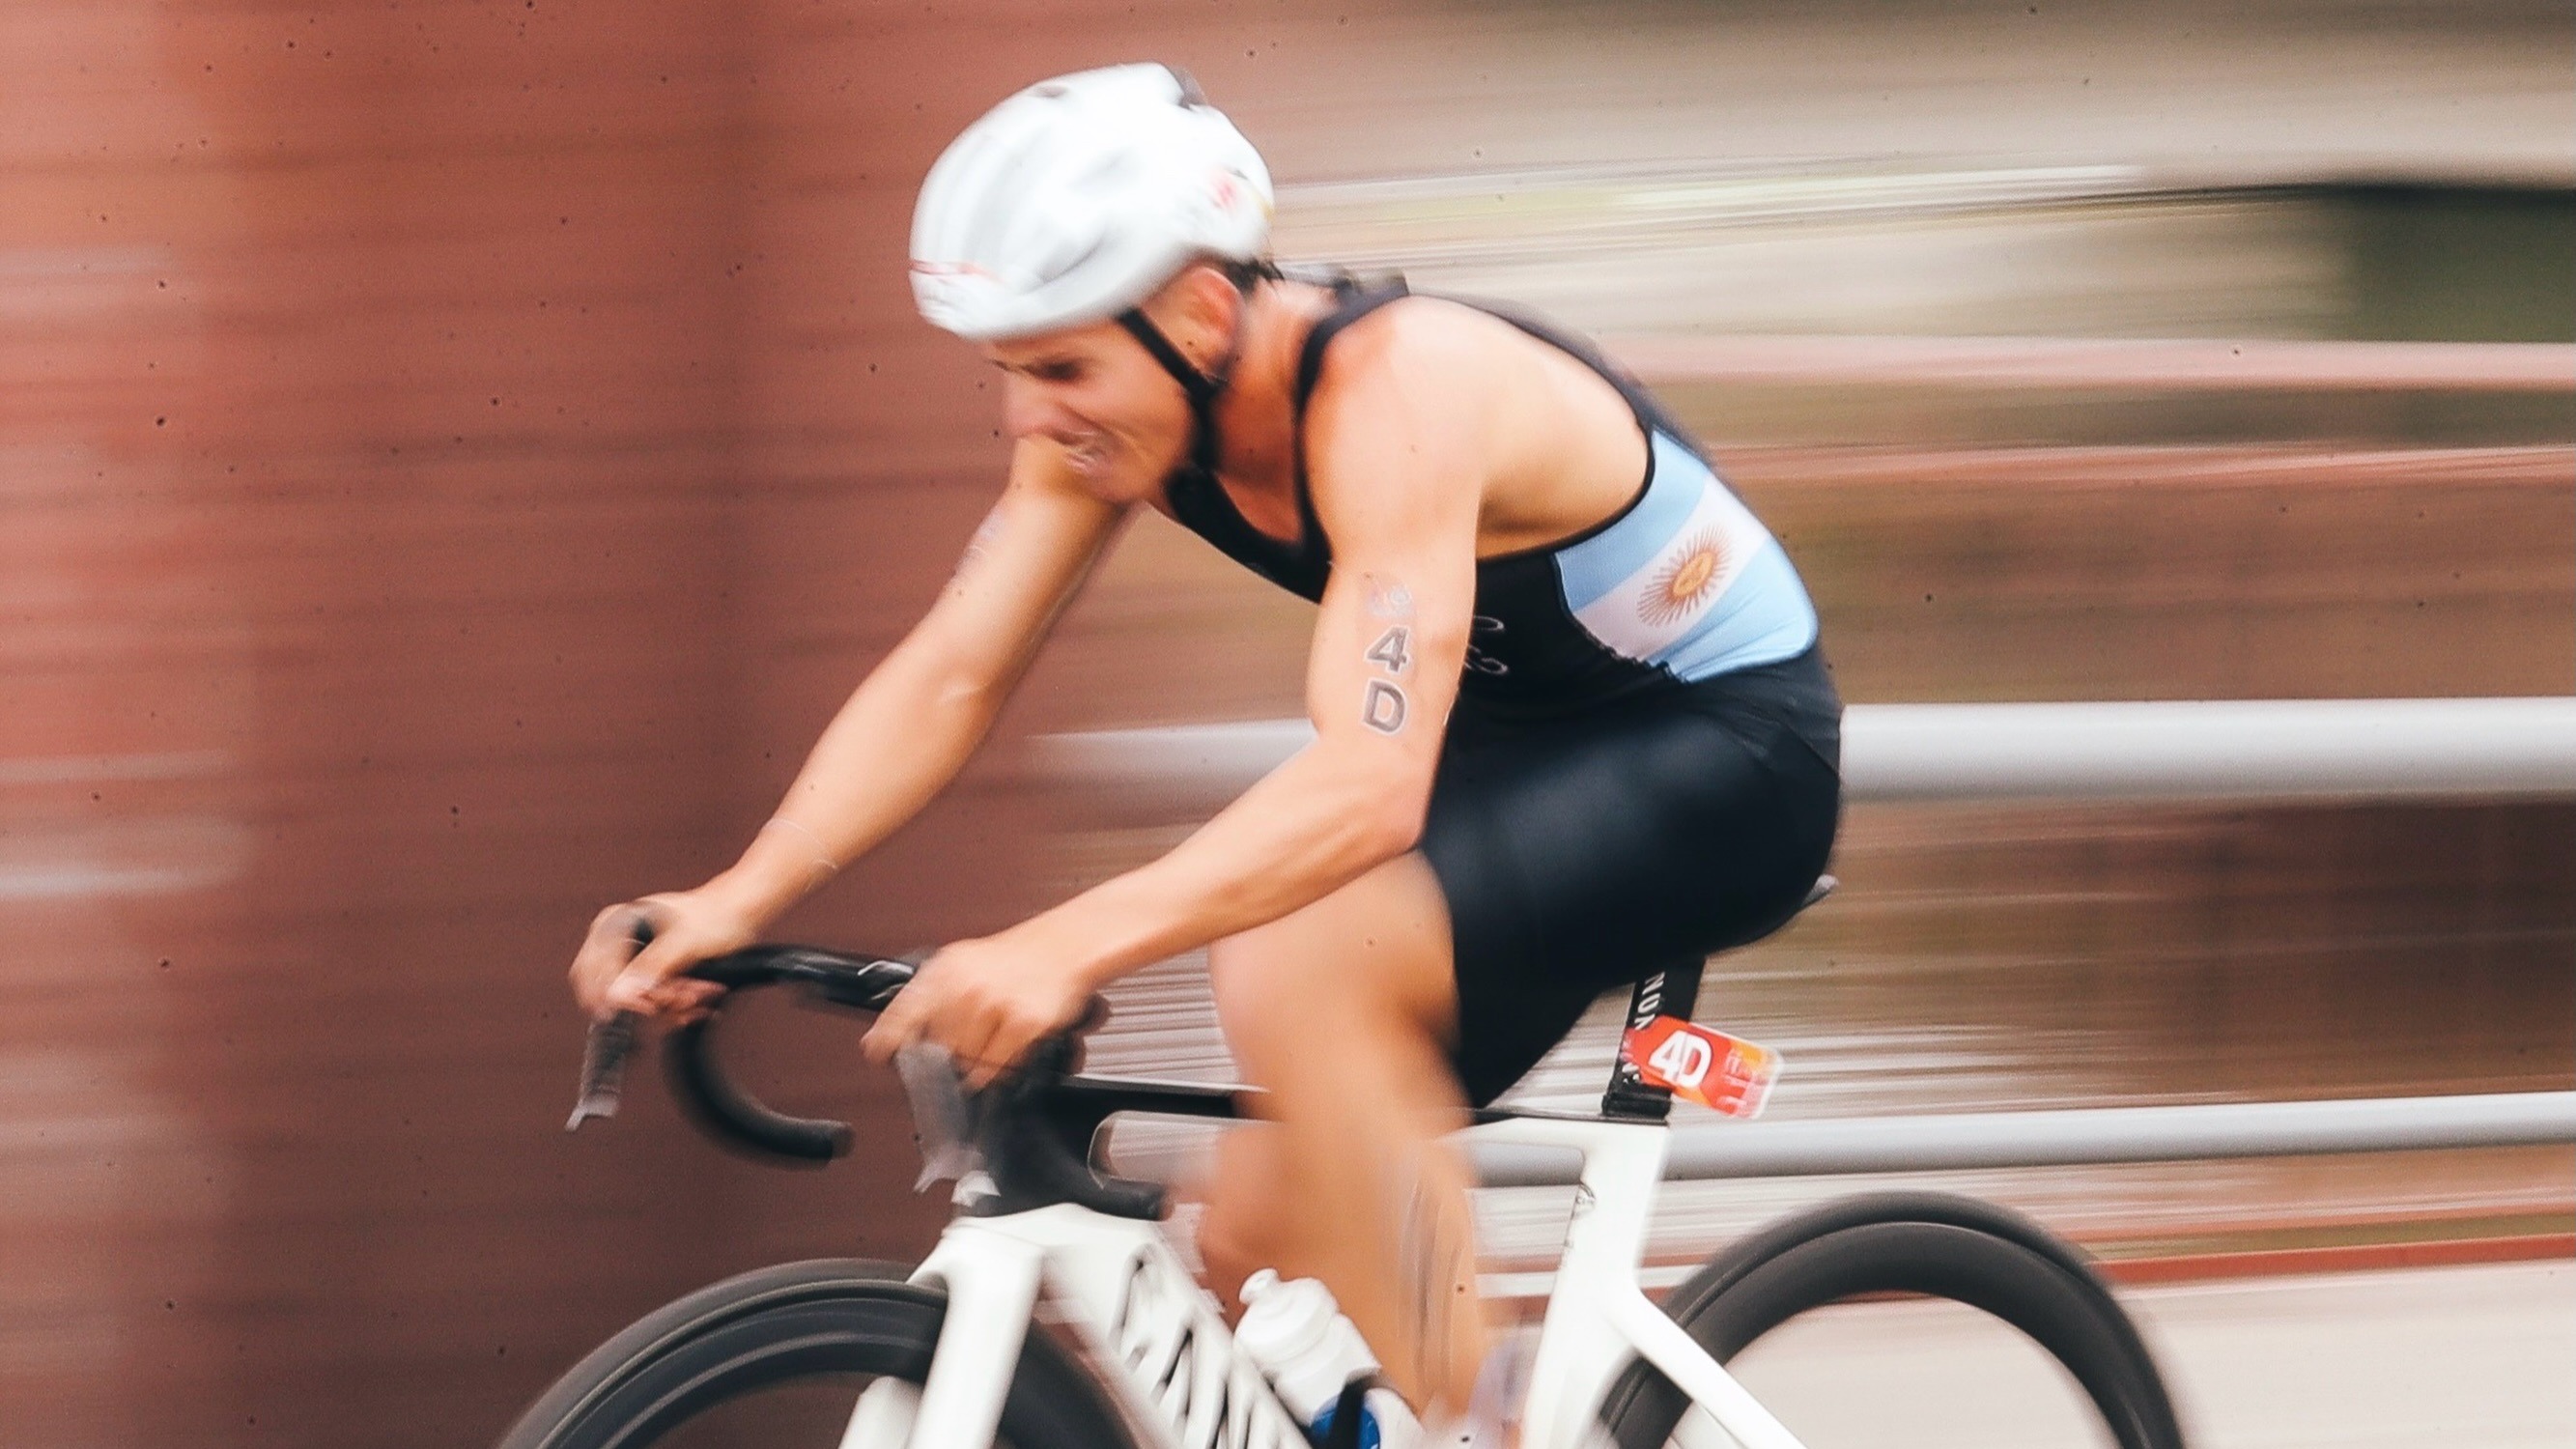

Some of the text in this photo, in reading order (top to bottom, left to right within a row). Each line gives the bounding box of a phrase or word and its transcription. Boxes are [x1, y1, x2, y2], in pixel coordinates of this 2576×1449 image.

[1365, 624, 1409, 673] 4
[1362, 678, 1406, 735] D
[1648, 1030, 1712, 1089] 4D
